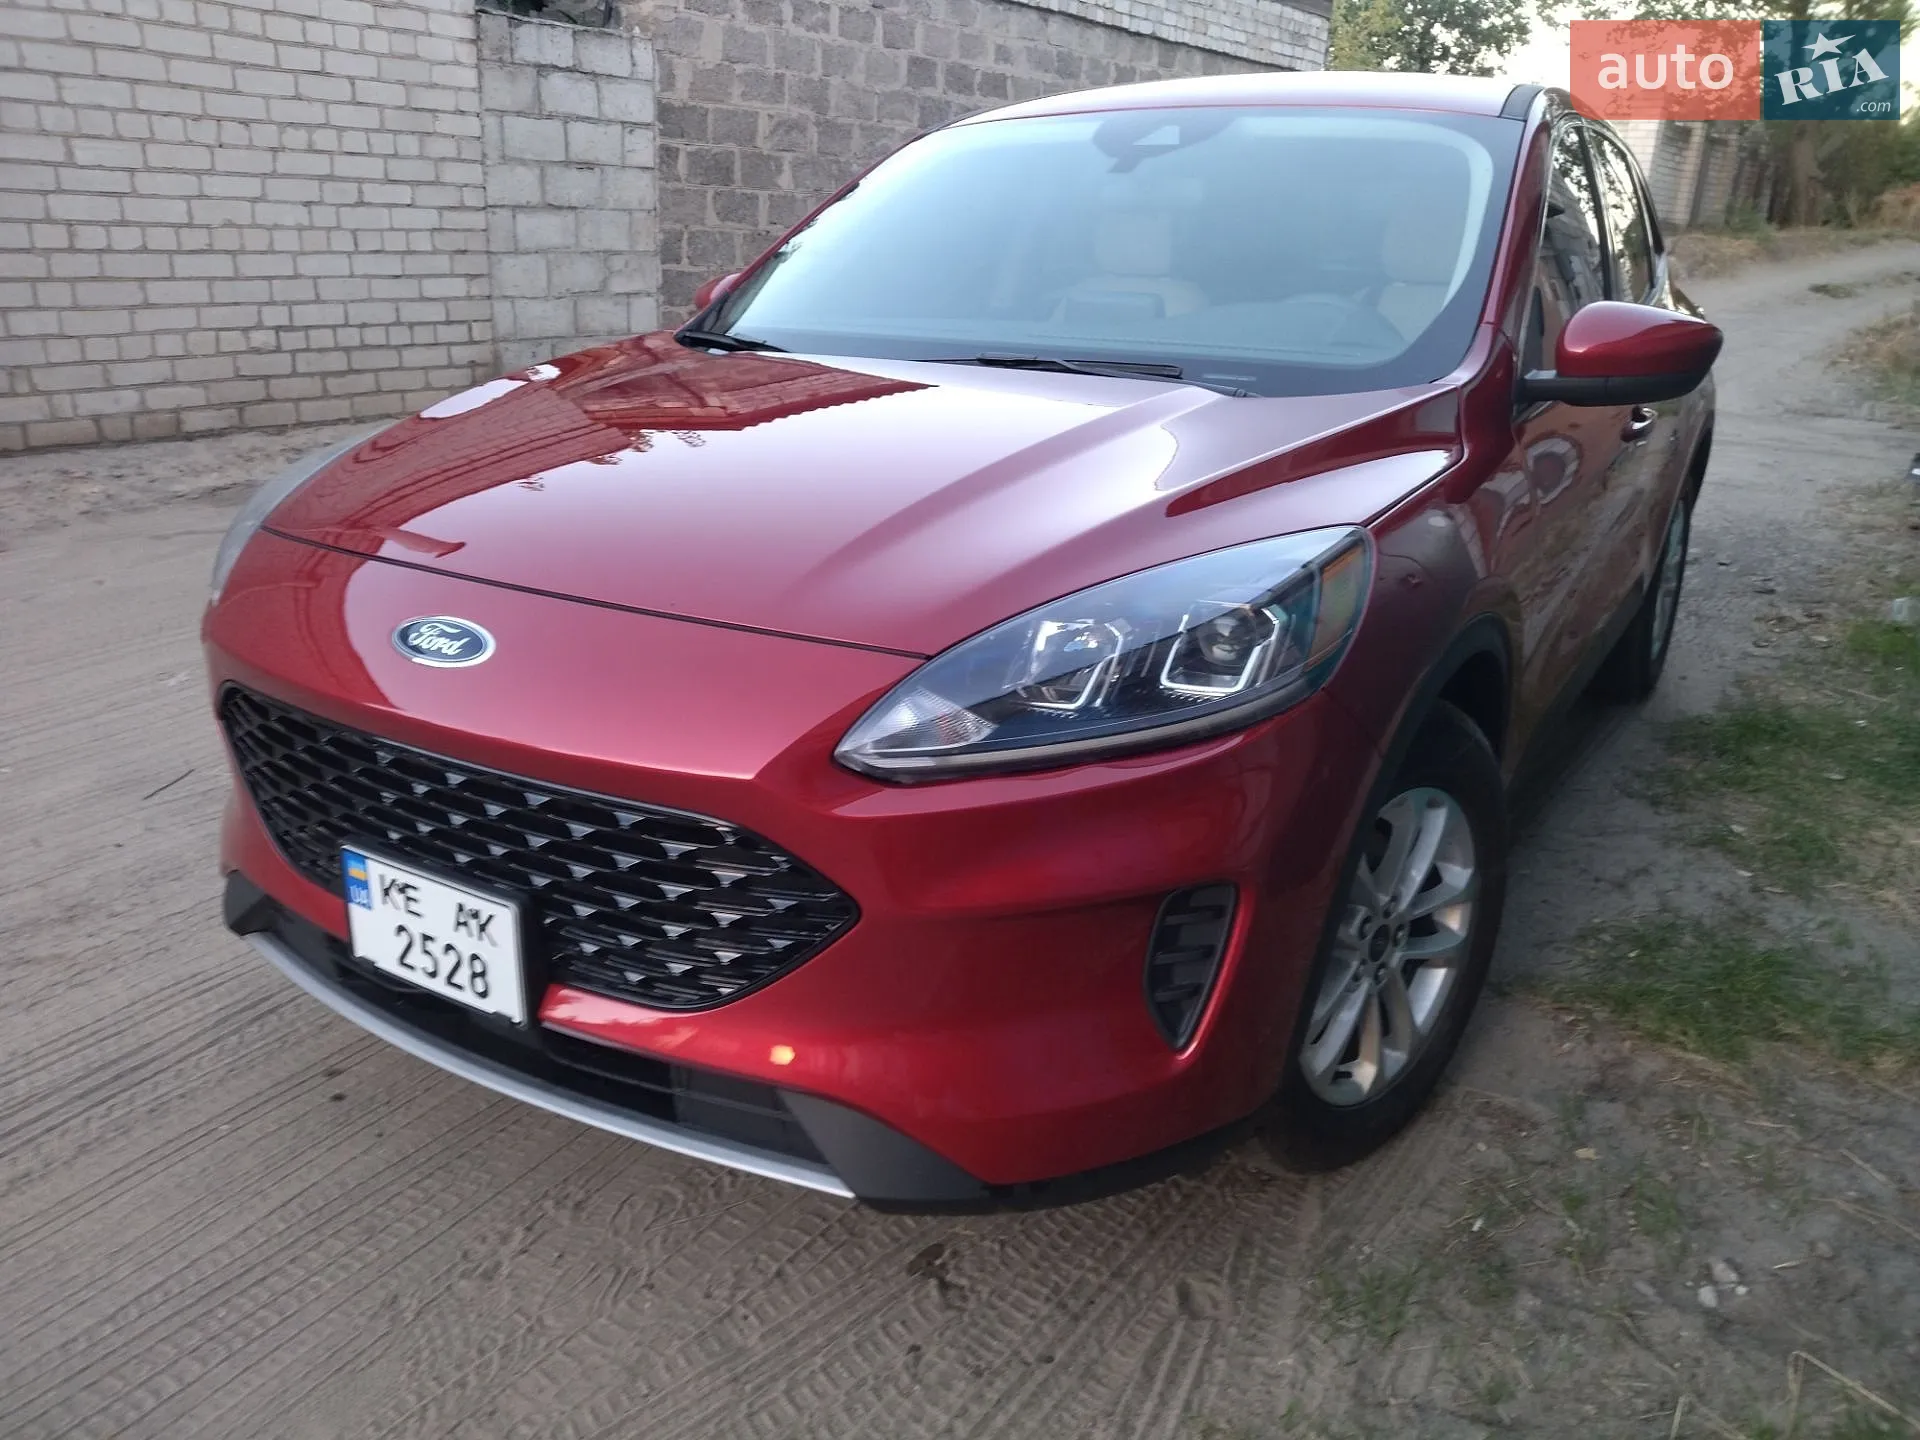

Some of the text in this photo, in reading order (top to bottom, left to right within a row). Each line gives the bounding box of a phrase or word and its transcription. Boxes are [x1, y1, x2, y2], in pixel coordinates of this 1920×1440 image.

[408, 622, 471, 655] Ford
[378, 873, 499, 948] KE AK
[394, 923, 490, 999] 2528
